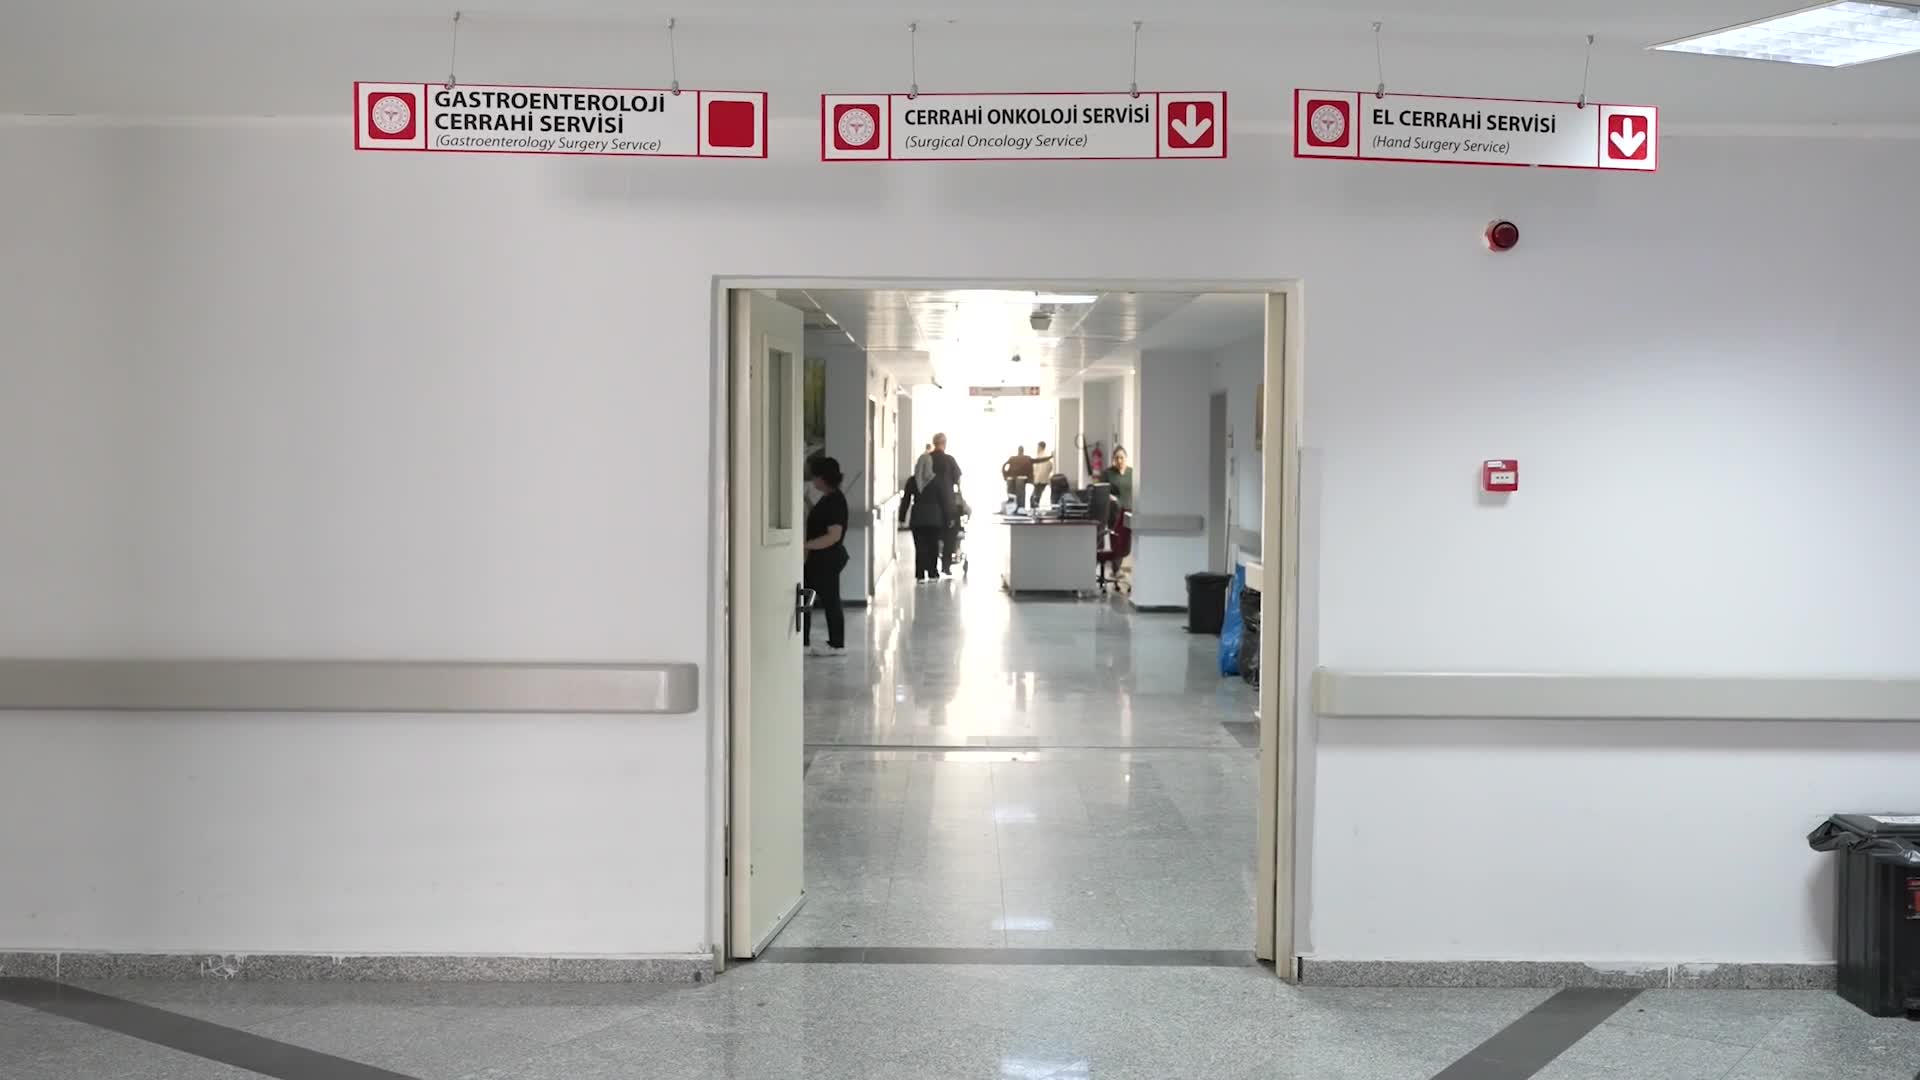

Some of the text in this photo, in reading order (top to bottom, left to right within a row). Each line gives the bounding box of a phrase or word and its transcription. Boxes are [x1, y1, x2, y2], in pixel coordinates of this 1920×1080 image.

[435, 91, 665, 112] GASTROENTEROLOJİ
[435, 111, 623, 133] CERRAHİ SERVİSİ
[905, 104, 1149, 125] CERRAHİ ONKOLOJİ SERVİSİ
[1373, 109, 1556, 133] EL CERRAHİ SERVİSİ
[436, 134, 555, 151] (Gastroenterology
[558, 136, 608, 152] Surgery
[905, 134, 1088, 151] (Surgical Oncology Service)
[1372, 135, 1510, 155] (Hand Surgery Service)
